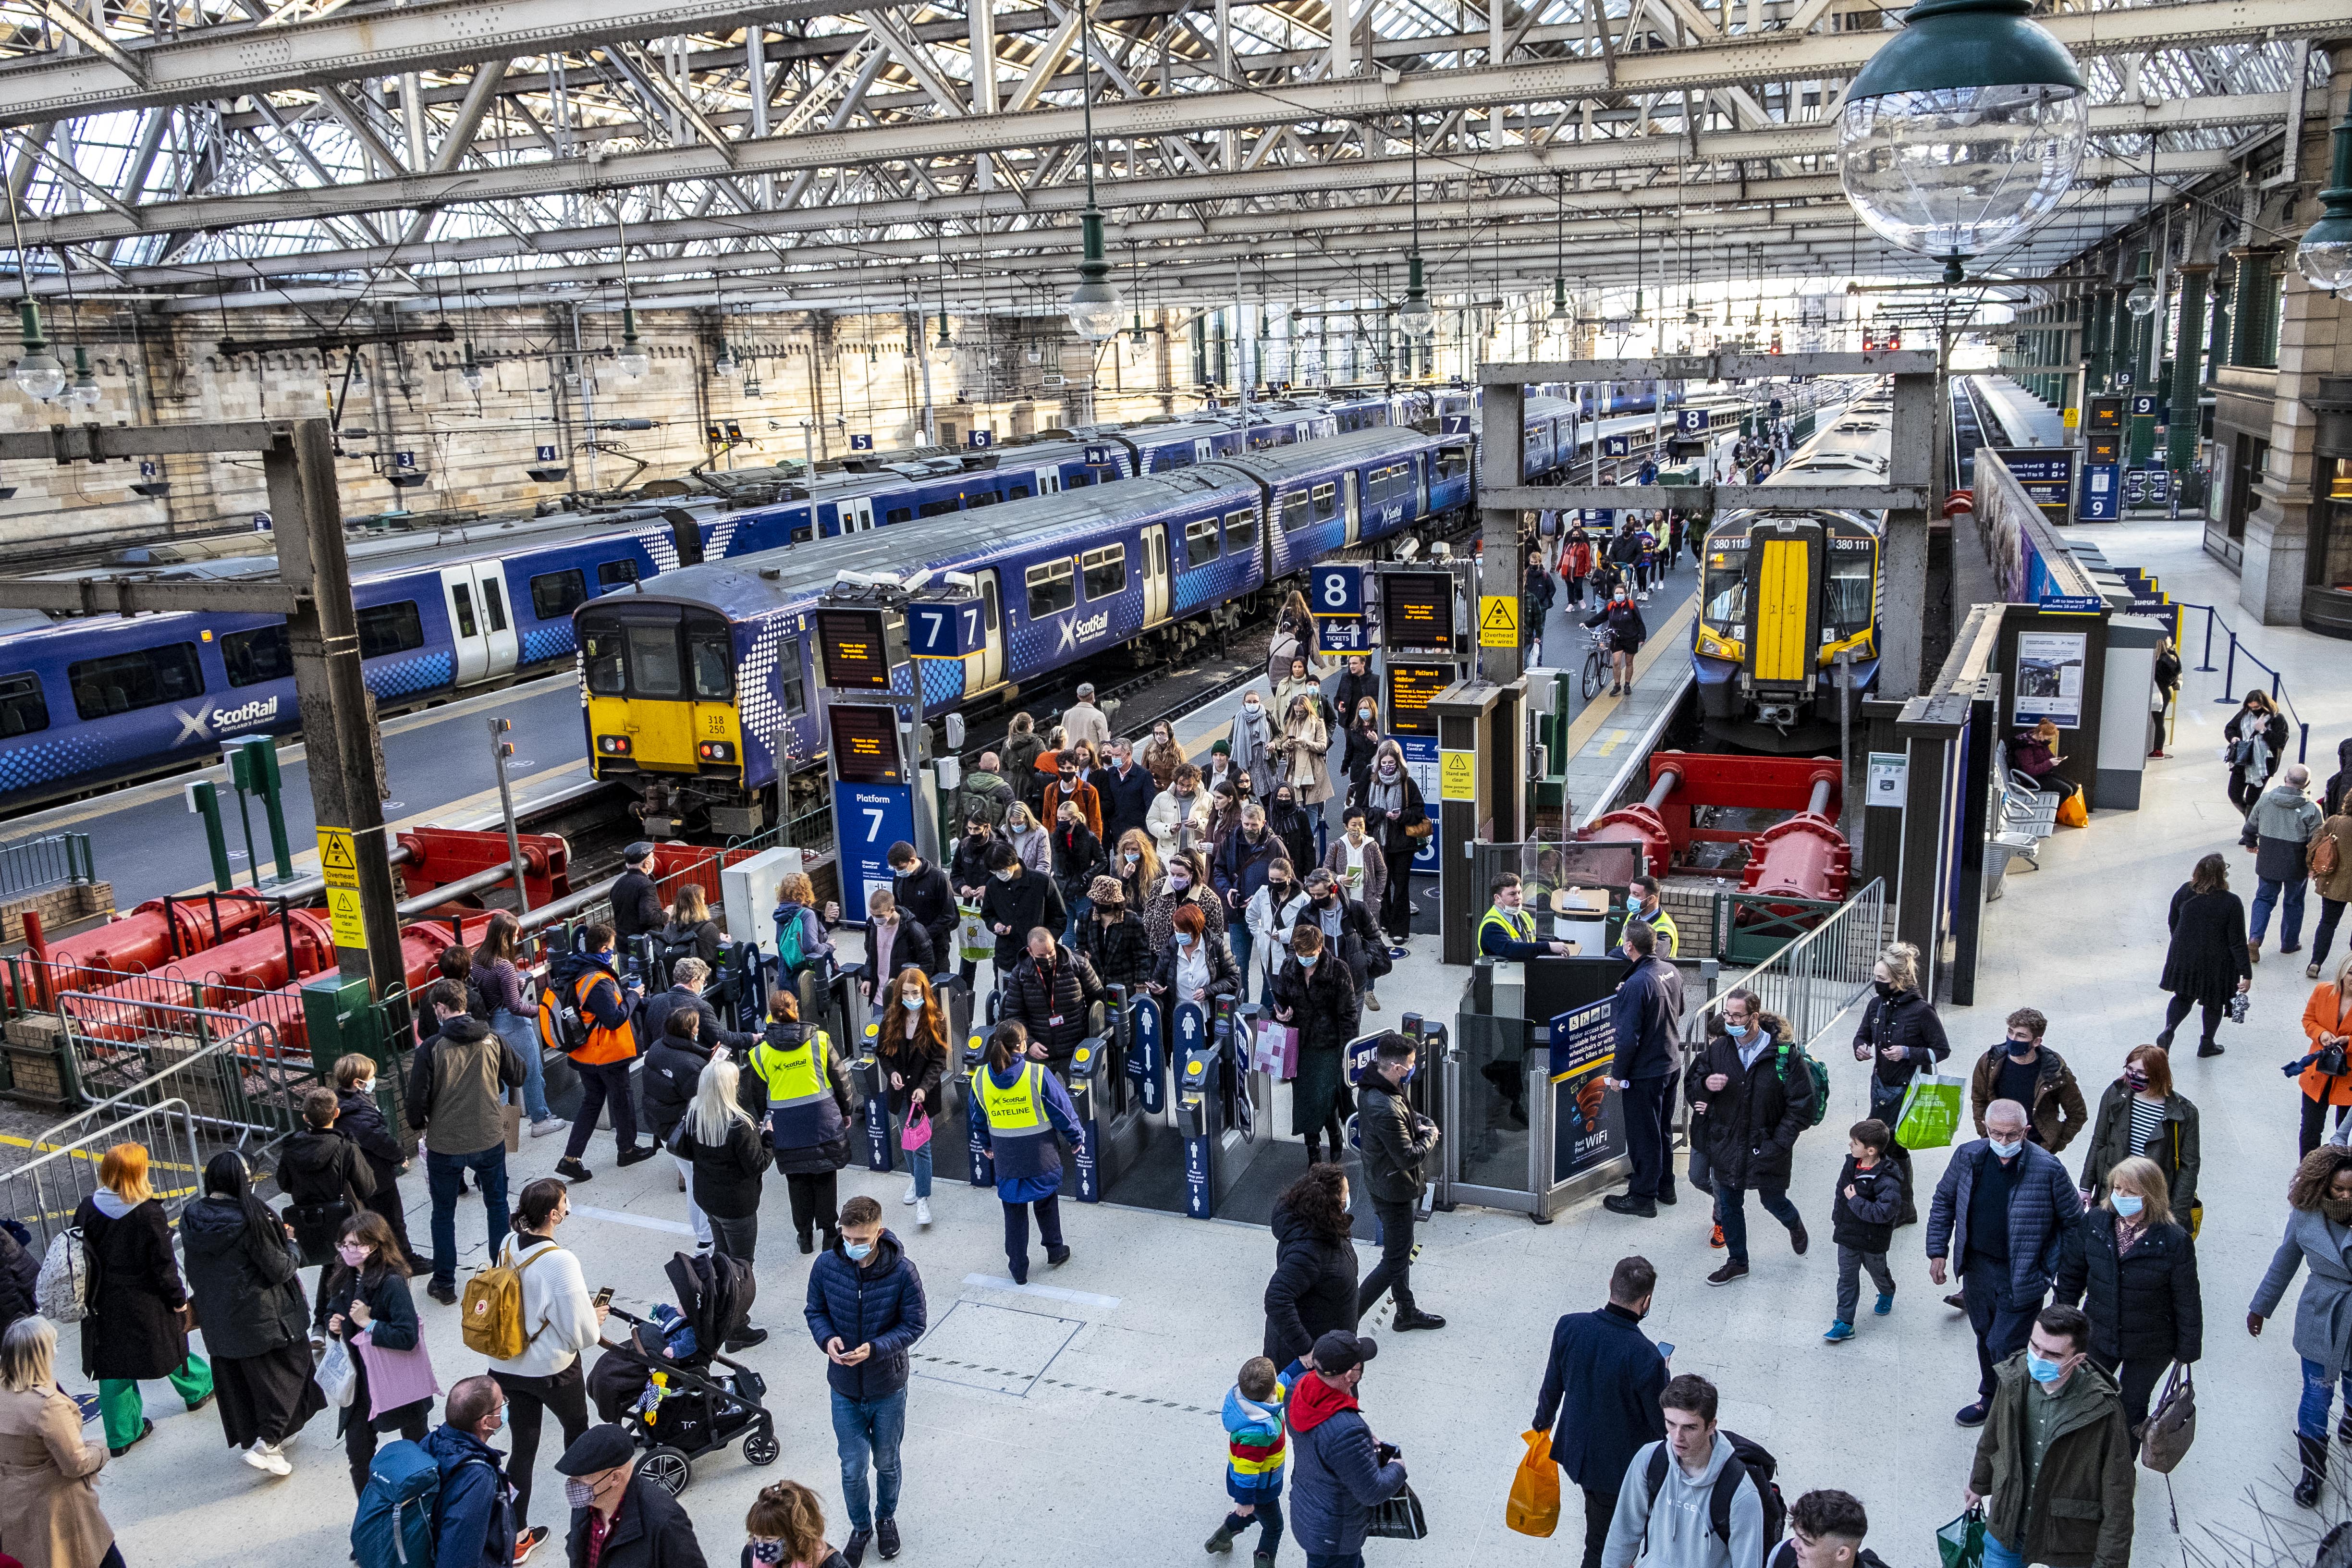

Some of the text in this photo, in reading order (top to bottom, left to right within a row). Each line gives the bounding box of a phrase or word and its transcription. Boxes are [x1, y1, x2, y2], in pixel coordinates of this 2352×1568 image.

[2121, 374, 2129, 383] 9
[2139, 399, 2150, 412] 9
[1450, 417, 1462, 433] 7
[1687, 411, 1699, 428] 8
[857, 435, 866, 450] 5
[975, 431, 985, 446] 6
[403, 453, 410, 466] 3
[542, 447, 551, 460] 4
[145, 463, 152, 475] 2
[2093, 501, 2103, 515] 9
[1714, 539, 1746, 549] 380 111
[1836, 539, 1869, 550] 380 111
[1325, 574, 1347, 606] 8
[921, 612, 943, 647] 7
[964, 609, 977, 645] 7
[1076, 610, 1108, 638] ScotRail
[1736, 628, 1742, 637] 2
[1826, 631, 1832, 639] 2
[213, 695, 277, 728] ScotRail
[708, 715, 724, 724] 318
[709, 725, 725, 734] 250
[856, 794, 890, 804] Platform
[863, 808, 883, 842] 7
[326, 871, 355, 880] Overhead
[1569, 1022, 1610, 1041] Wider access gate
[1569, 1037, 1589, 1050] available
[1569, 1043, 1596, 1057] wheelchairs
[783, 1058, 807, 1068] ScotRail
[1569, 1056, 1584, 1067] prams,
[1586, 1050, 1597, 1059] bikes
[991, 1107, 1030, 1116] GATELINE
[1575, 1129, 1607, 1149] Fast WiFi
